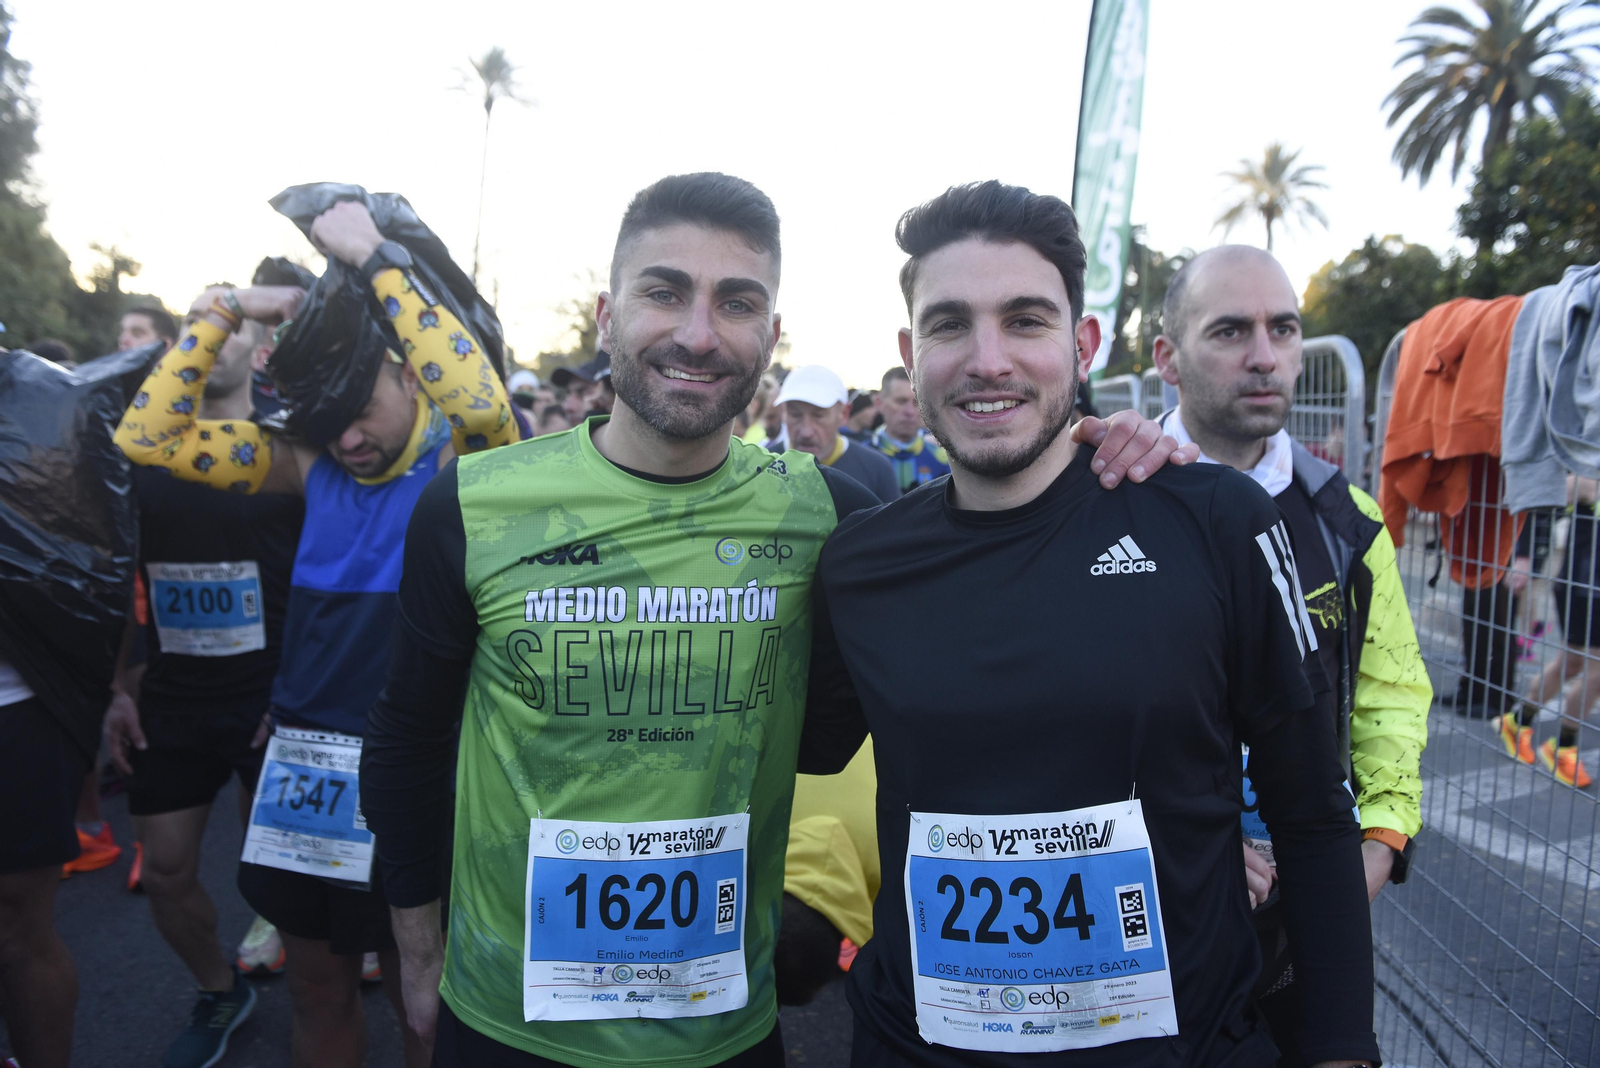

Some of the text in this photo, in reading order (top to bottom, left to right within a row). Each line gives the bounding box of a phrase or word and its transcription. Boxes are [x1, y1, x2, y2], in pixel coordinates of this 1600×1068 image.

[748, 537, 793, 565] edp
[1090, 559, 1157, 576] adidas
[166, 586, 233, 615] 2100
[524, 578, 779, 623] MEDIO MARATÓN
[506, 626, 782, 716] SEVILLA
[606, 727, 695, 742] 28ª Edición
[277, 773, 348, 816] 1547
[582, 831, 621, 856] edp
[648, 826, 714, 843] maratón
[665, 837, 714, 854] sevilla
[947, 826, 984, 854] edp
[1010, 821, 1098, 841] maratón
[1034, 835, 1100, 855] sevilla
[565, 870, 699, 931] 1620
[937, 872, 1095, 945] 2234
[597, 948, 684, 960] Emilio Medina
[636, 964, 671, 984] edp
[934, 958, 1141, 980] JOSE ANTONIO CHAVEZ GATA
[591, 993, 619, 1002] HOKA
[950, 987, 971, 995] CAMISETA
[1028, 984, 1070, 1010] edp
[1117, 992, 1136, 1000] Edición
[982, 1022, 1014, 1033] HOKA
[1019, 1028, 1055, 1036] RUNNING
